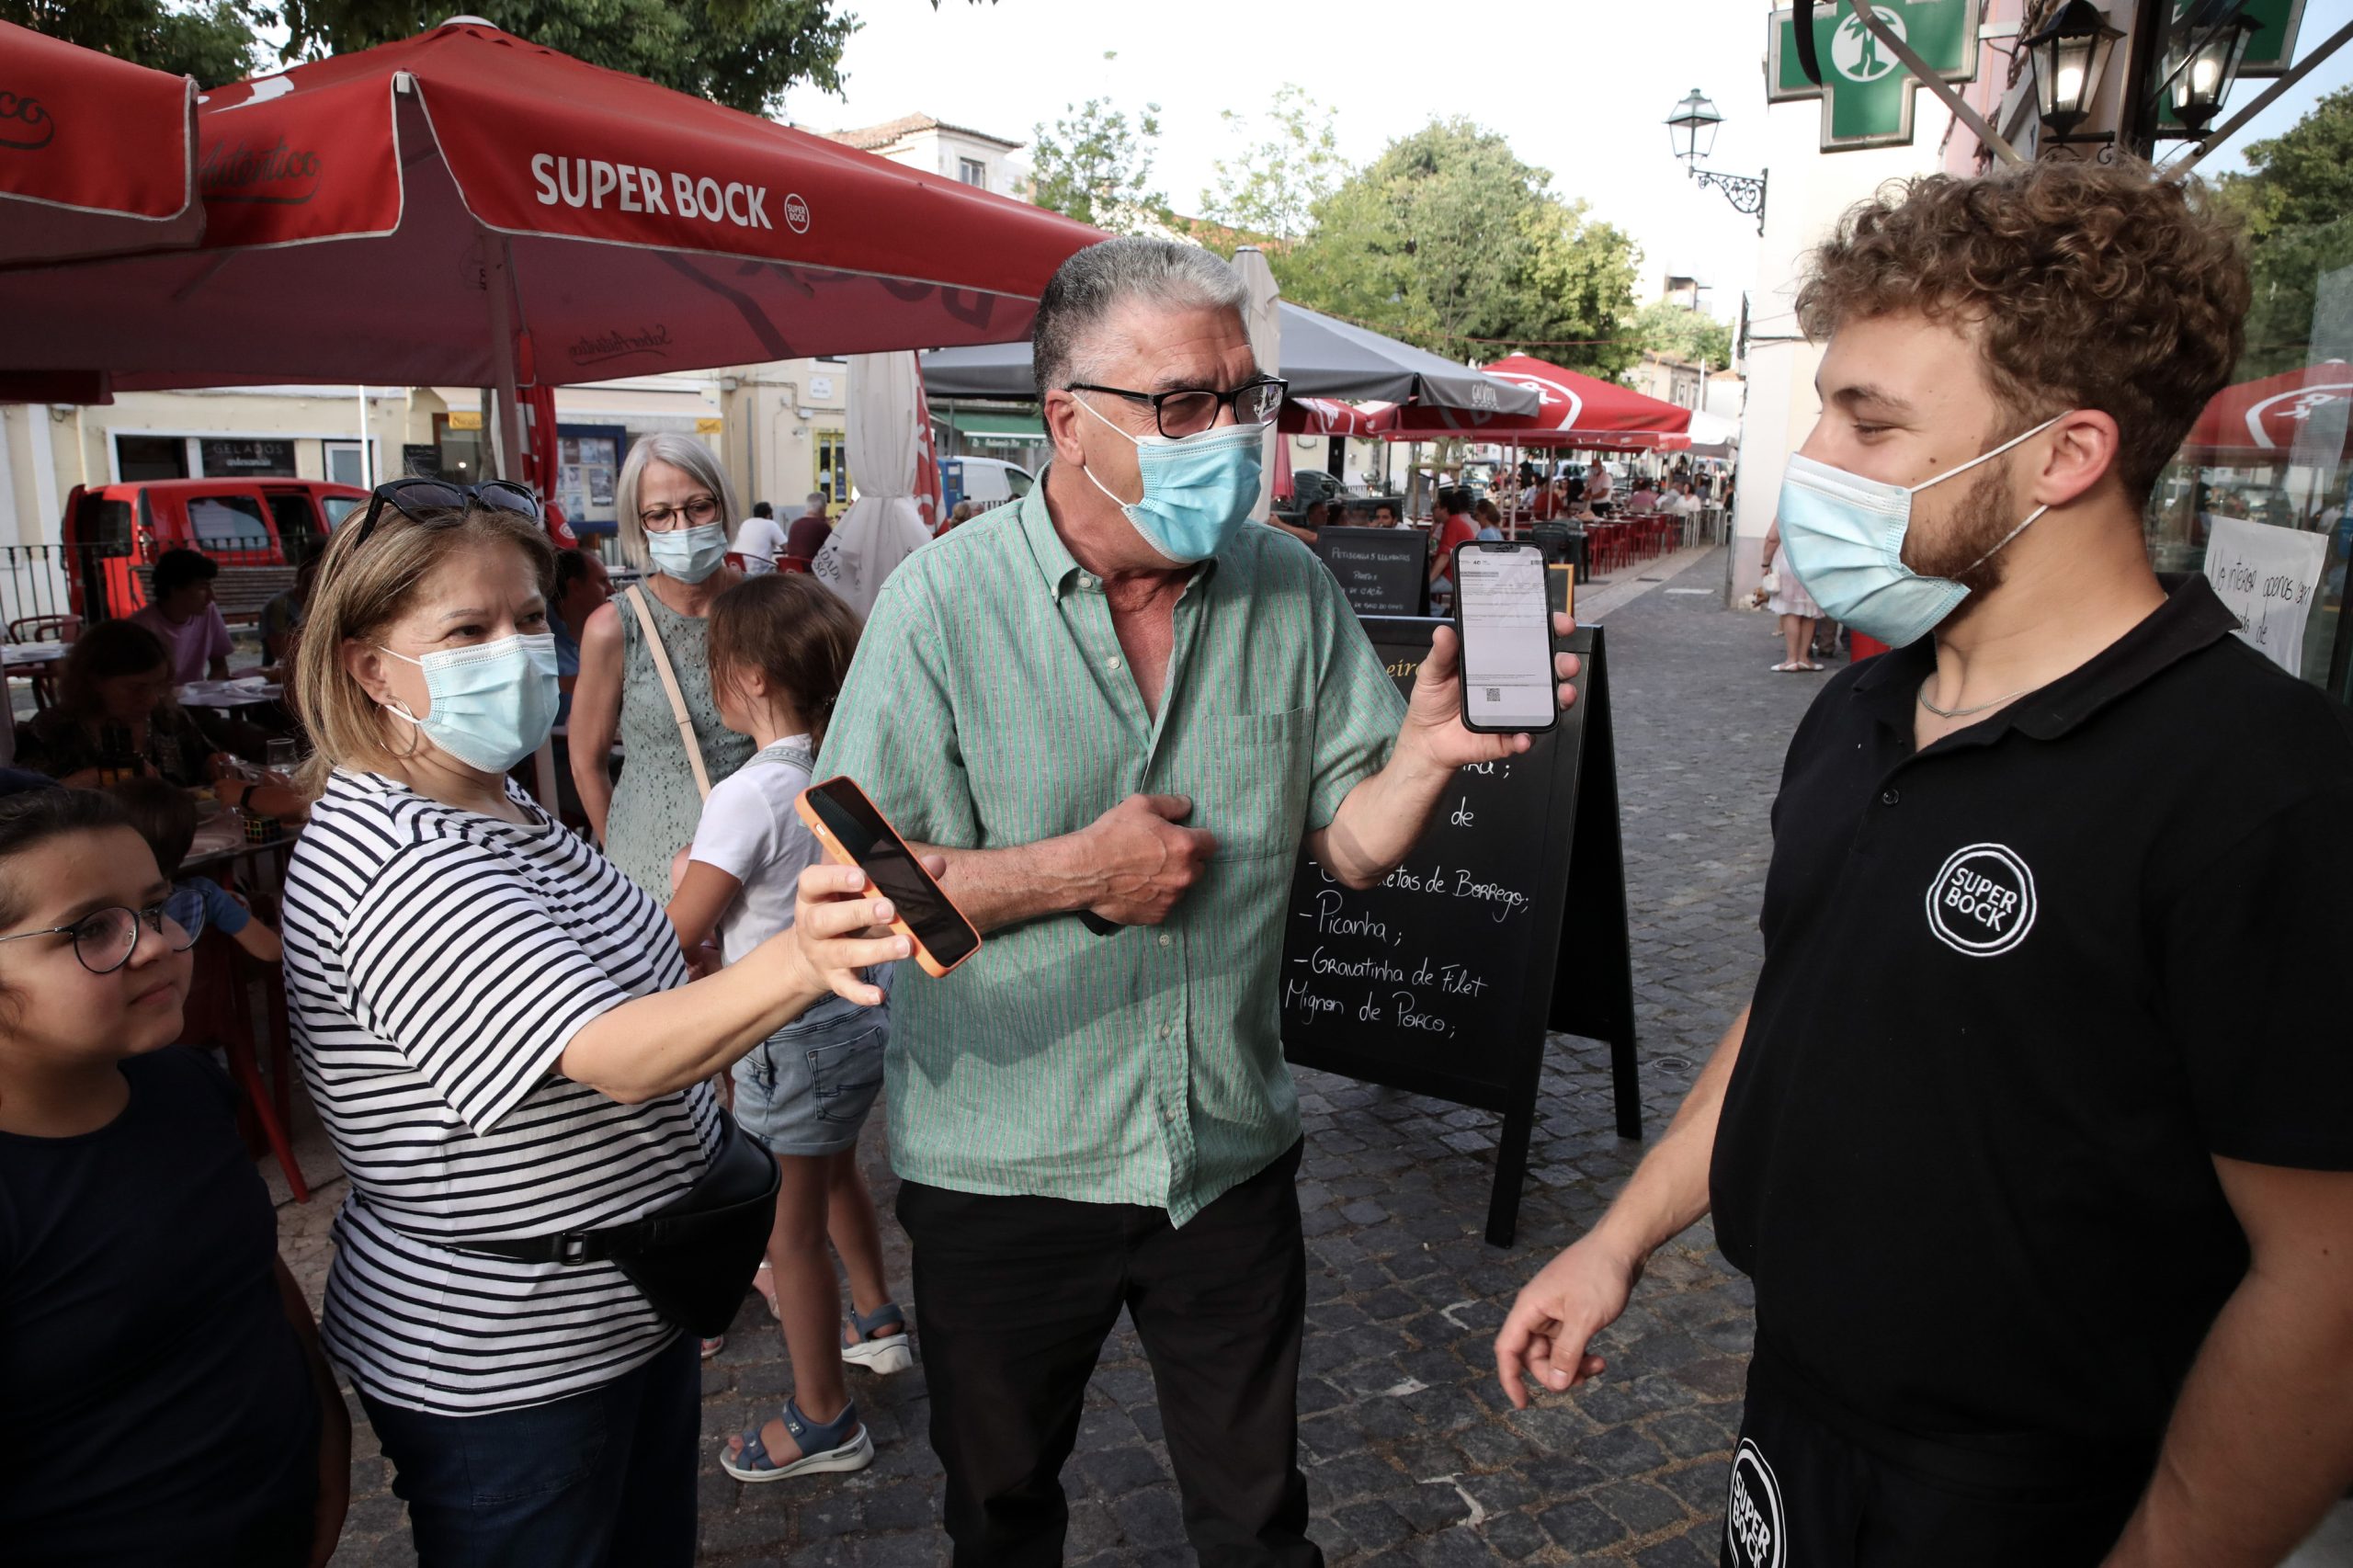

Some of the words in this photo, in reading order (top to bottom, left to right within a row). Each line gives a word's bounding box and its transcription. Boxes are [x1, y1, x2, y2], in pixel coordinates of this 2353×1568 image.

[531, 153, 670, 215] SUPER
[671, 172, 773, 230] BOCK
[787, 203, 805, 215] SUPER
[789, 212, 807, 223] BOCK
[212, 443, 284, 455] GELADOS
[1450, 796, 1474, 827] de
[1425, 866, 1446, 893] de
[1950, 867, 2018, 915] SUPER
[1944, 886, 2007, 932] BOCK
[1412, 957, 1434, 986] de
[1440, 964, 1489, 997] Filet
[1285, 978, 1345, 1026] Mignon
[1358, 991, 1381, 1022] de
[1732, 1497, 1763, 1568] BOCK
[1733, 1470, 1771, 1559] SUPER
